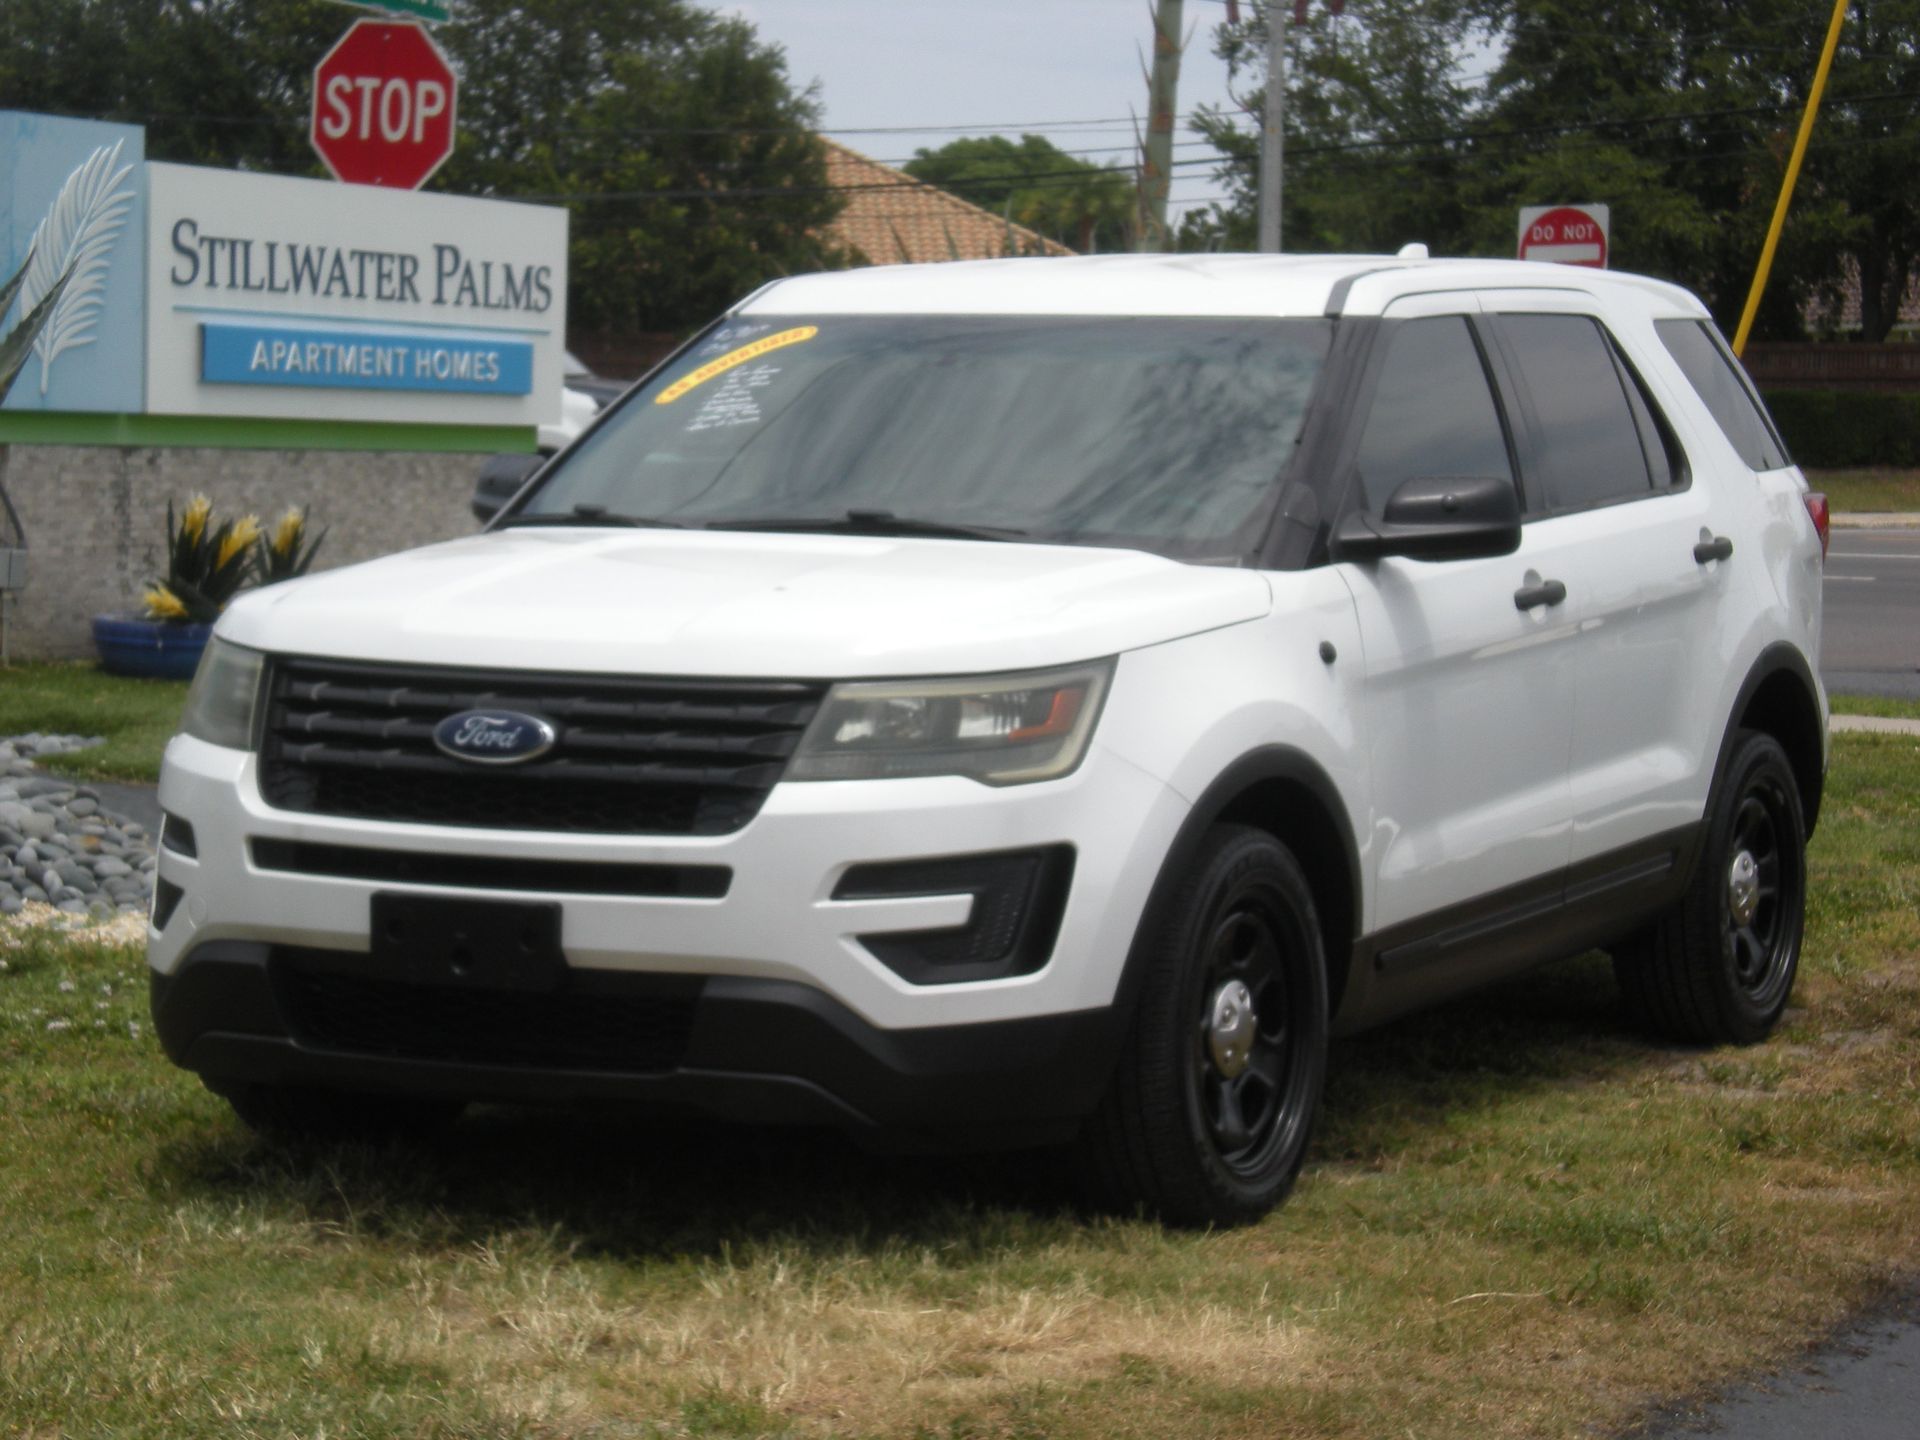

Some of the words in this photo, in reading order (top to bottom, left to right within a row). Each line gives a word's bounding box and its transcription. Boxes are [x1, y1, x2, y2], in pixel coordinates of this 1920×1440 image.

[322, 75, 446, 143] STOP
[1533, 225, 1554, 240] DO
[1563, 224, 1594, 239] NOT
[170, 218, 419, 303] STILLWATER
[432, 244, 552, 313] PALMS
[250, 340, 407, 379] APARTMENT
[415, 351, 500, 381] HOMES
[454, 716, 522, 748] Ford
